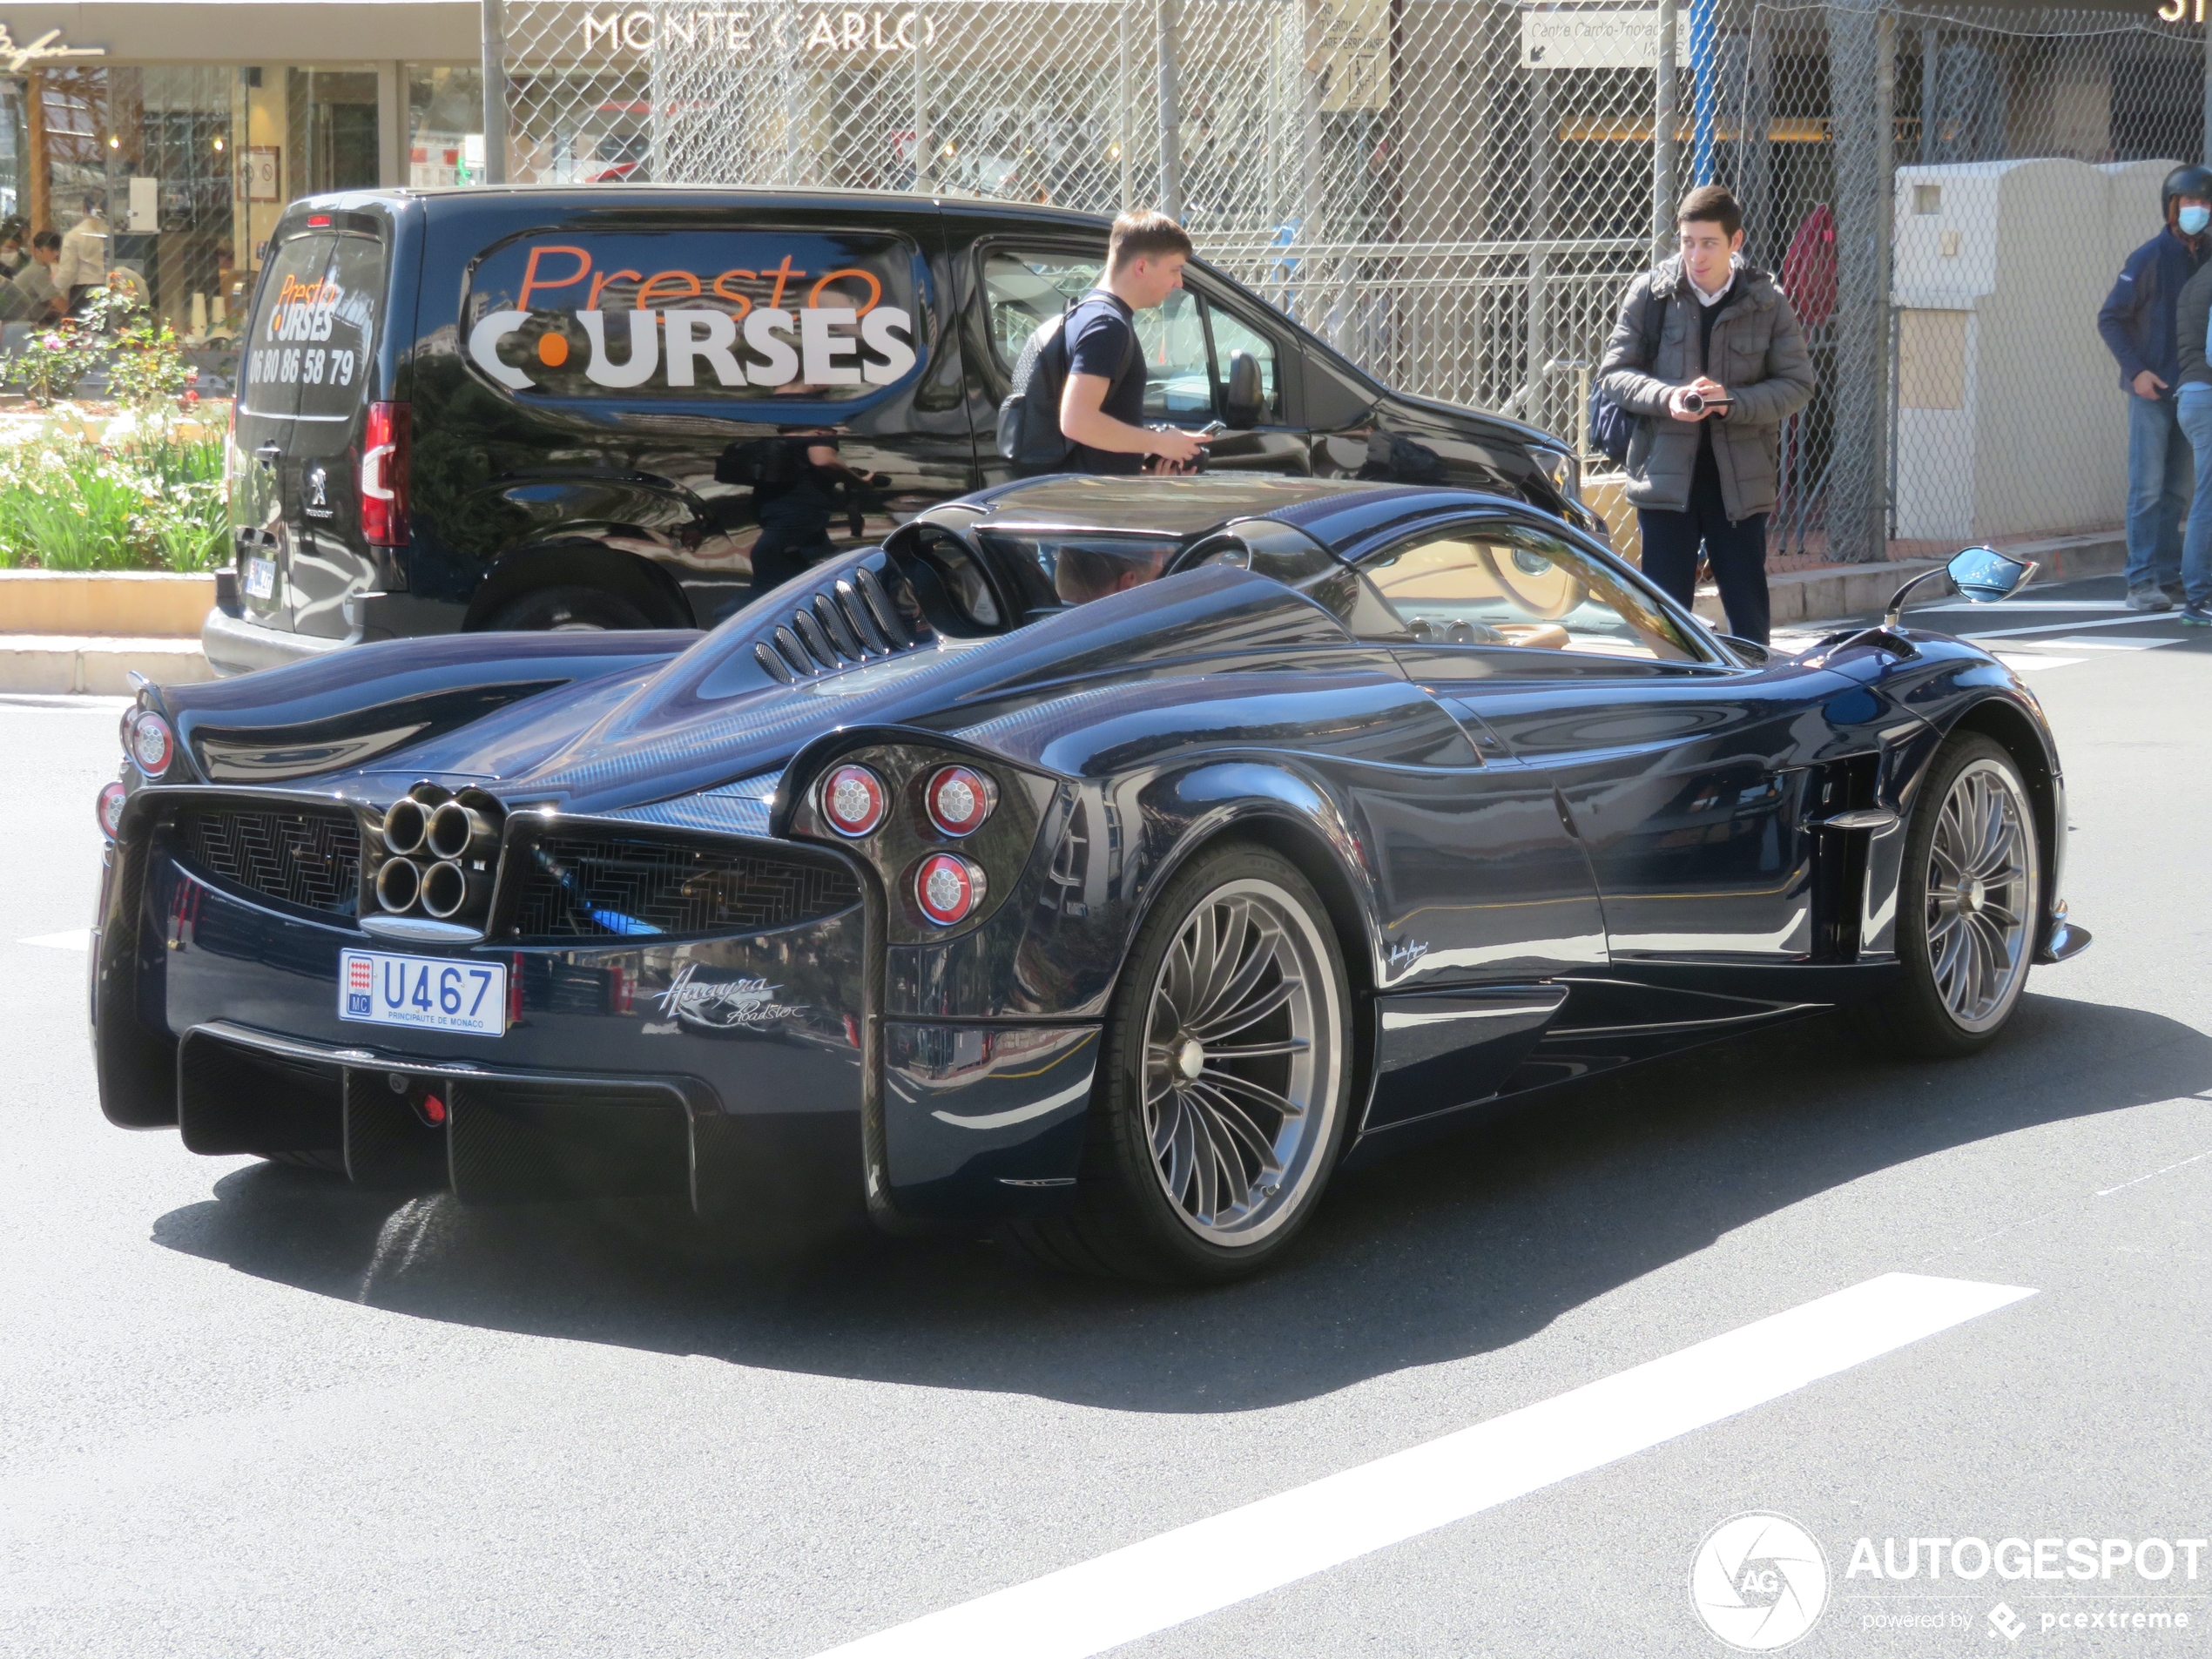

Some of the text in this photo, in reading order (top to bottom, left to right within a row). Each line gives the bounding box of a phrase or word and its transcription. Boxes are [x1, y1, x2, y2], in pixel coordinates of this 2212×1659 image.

[583, 10, 935, 51] MONTE CARLO
[1531, 23, 1571, 38] Centre
[276, 274, 338, 308] Presto
[516, 246, 882, 322] Presto
[469, 307, 917, 390] COURSES
[249, 348, 354, 386] 06 80 86 58 79
[306, 508, 334, 519] PEUGEOT
[352, 996, 368, 1012] MC
[384, 961, 493, 1017] U467
[652, 962, 785, 1019] Huayra
[388, 1011, 484, 1028] PRINCIPAUTE DE MONACO
[726, 999, 811, 1024] Roadster
